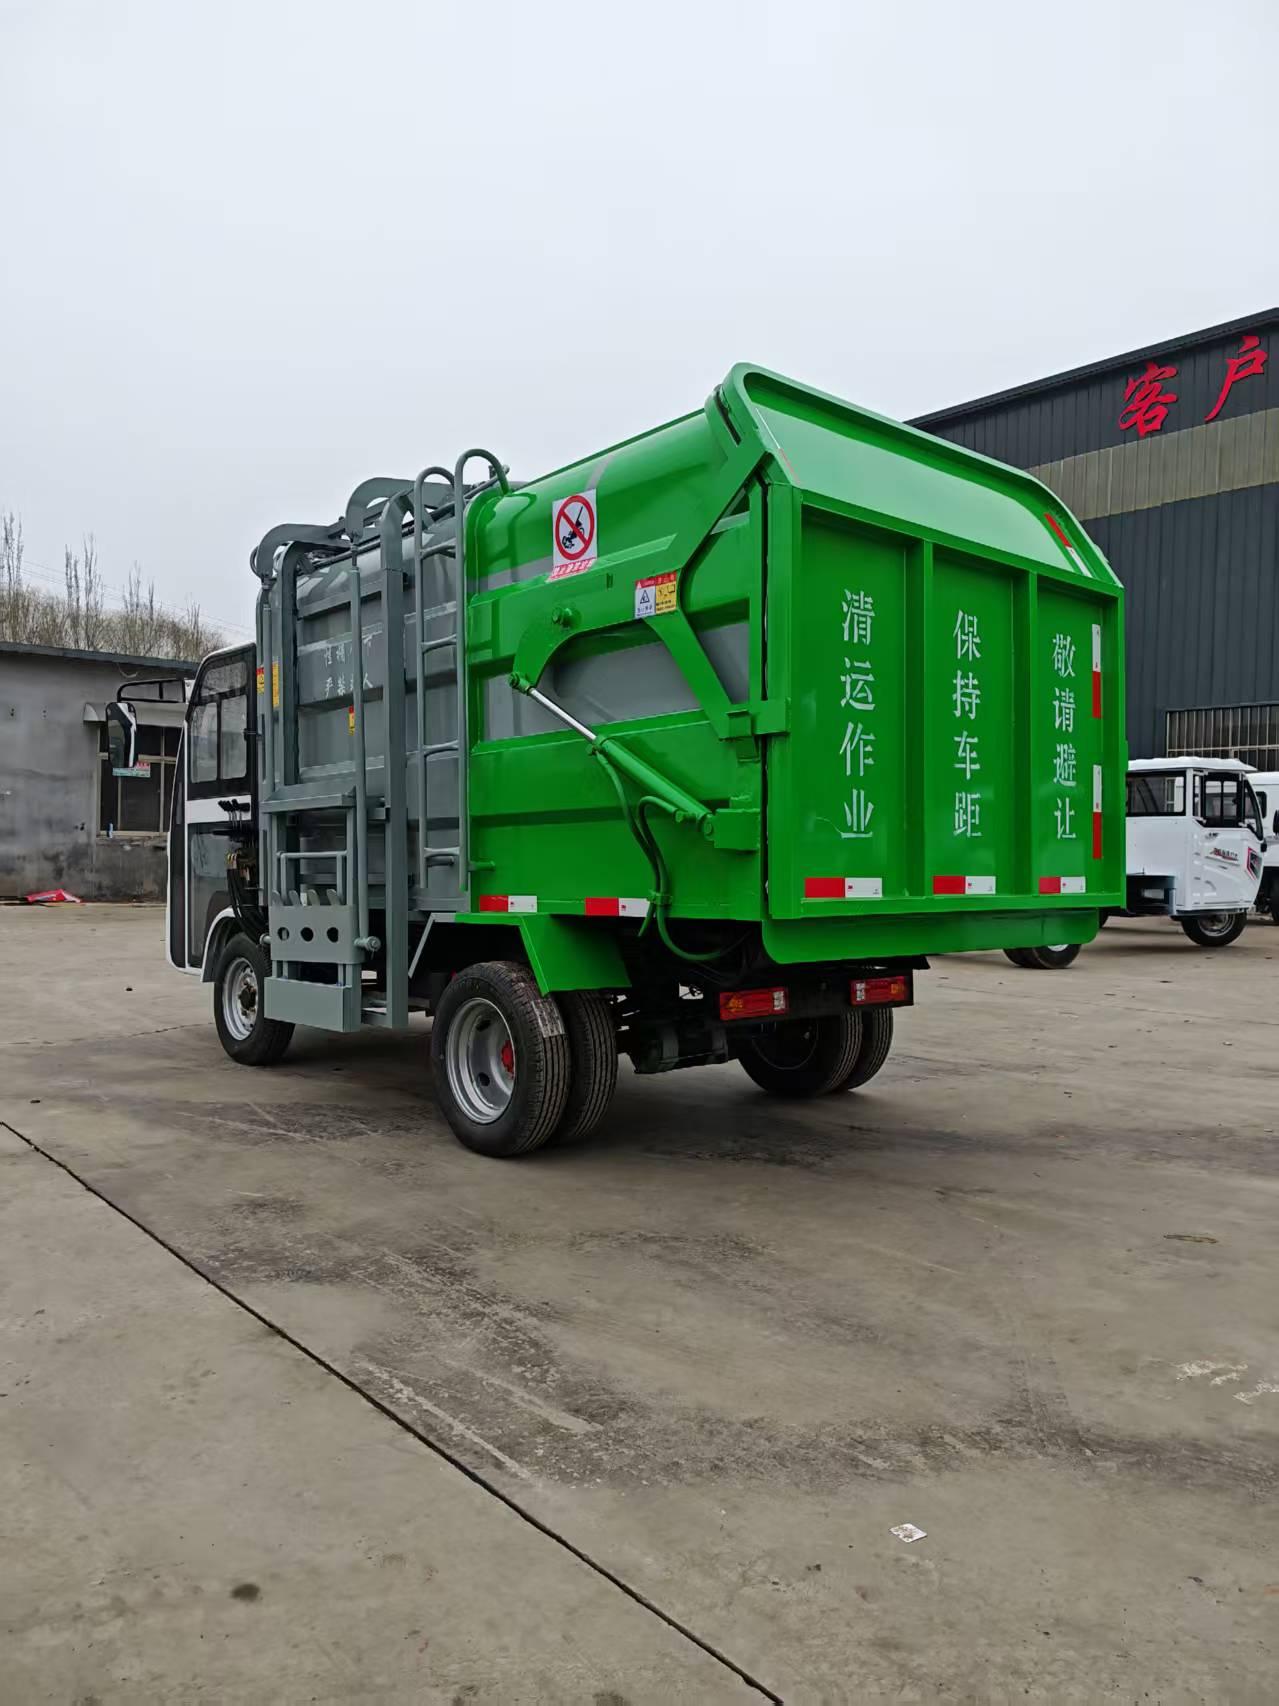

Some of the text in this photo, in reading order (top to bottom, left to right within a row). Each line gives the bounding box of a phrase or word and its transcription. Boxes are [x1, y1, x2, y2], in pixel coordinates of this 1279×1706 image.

[840, 589, 876, 839] 清运作业
[953, 609, 982, 838] 保持车距
[1052, 633, 1077, 840] 敬请避让
